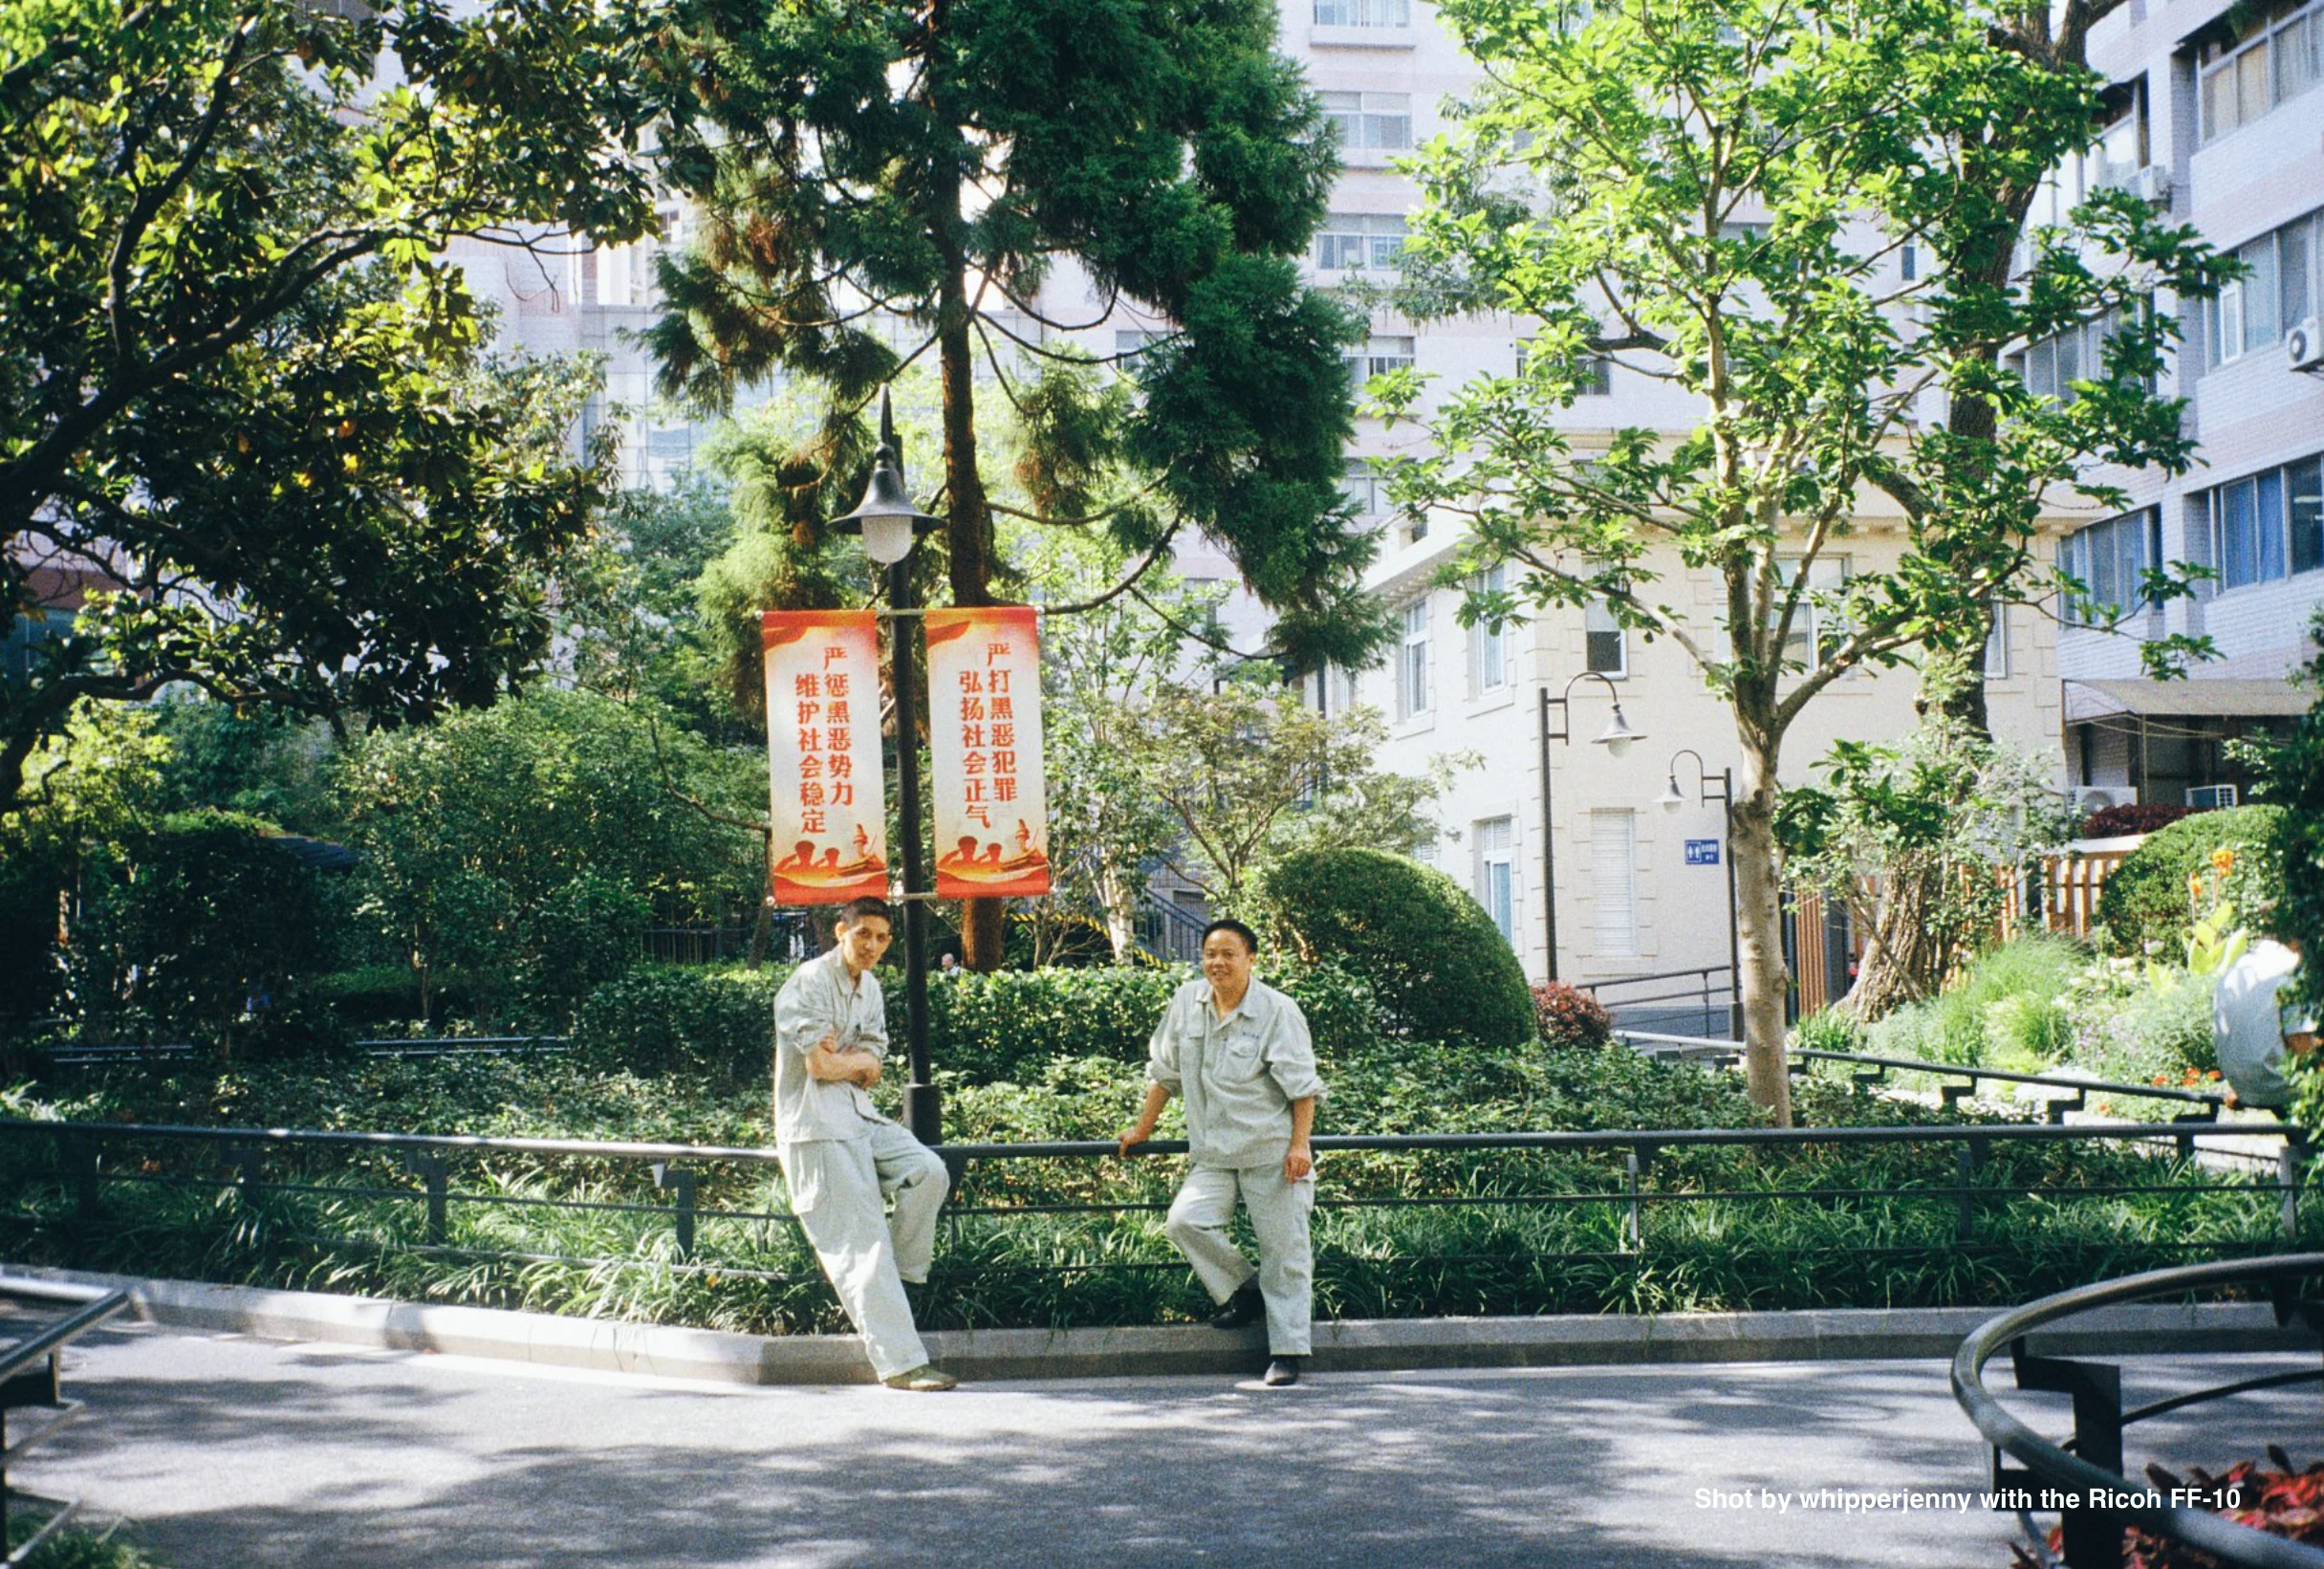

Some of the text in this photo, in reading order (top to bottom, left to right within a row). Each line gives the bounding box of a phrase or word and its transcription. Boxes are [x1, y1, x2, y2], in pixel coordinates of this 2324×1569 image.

[794, 673, 826, 834] 维护社会稳定
[823, 646, 854, 806] 严惩黑恶势力
[959, 670, 990, 829] 弘扬社会正气
[986, 643, 1017, 802] 严打黑恶犯罪
